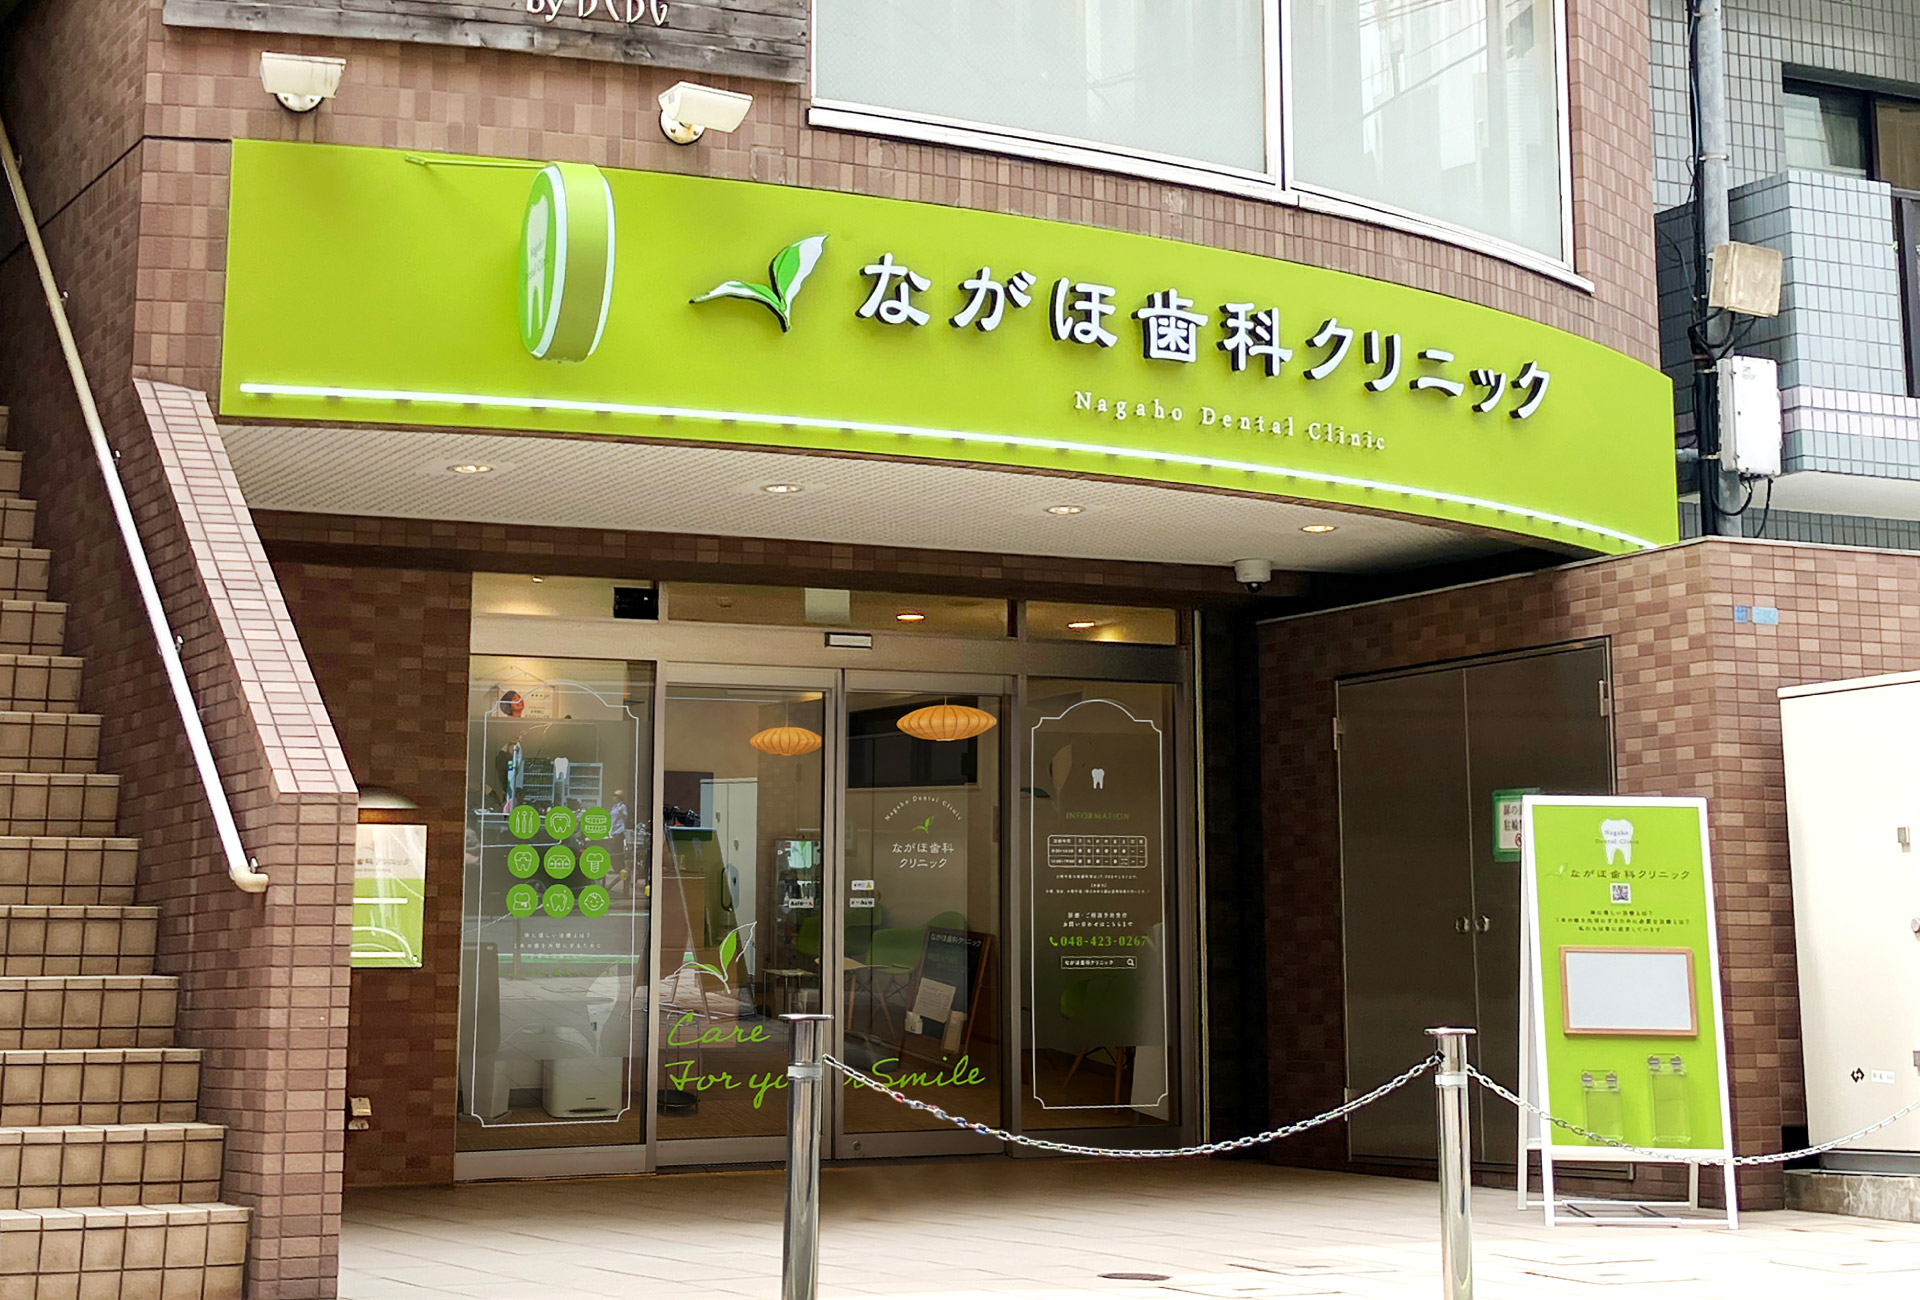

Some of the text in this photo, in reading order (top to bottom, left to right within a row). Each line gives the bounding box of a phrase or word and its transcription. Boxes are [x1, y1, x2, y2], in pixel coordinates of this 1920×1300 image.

[857, 252, 1552, 421] ながほ歯科クリニック
[1074, 391, 1386, 450] Nagaho Dental Clinic
[1066, 811, 1129, 820] INFORMATION
[891, 842, 955, 854] ながほ歯科
[899, 858, 948, 868] クリニック
[1570, 869, 1690, 880] ながほ歯科クリニック
[1060, 935, 1148, 947] 048-423-0267
[667, 1012, 771, 1047] Care
[664, 1055, 986, 1109] For yor Smile
